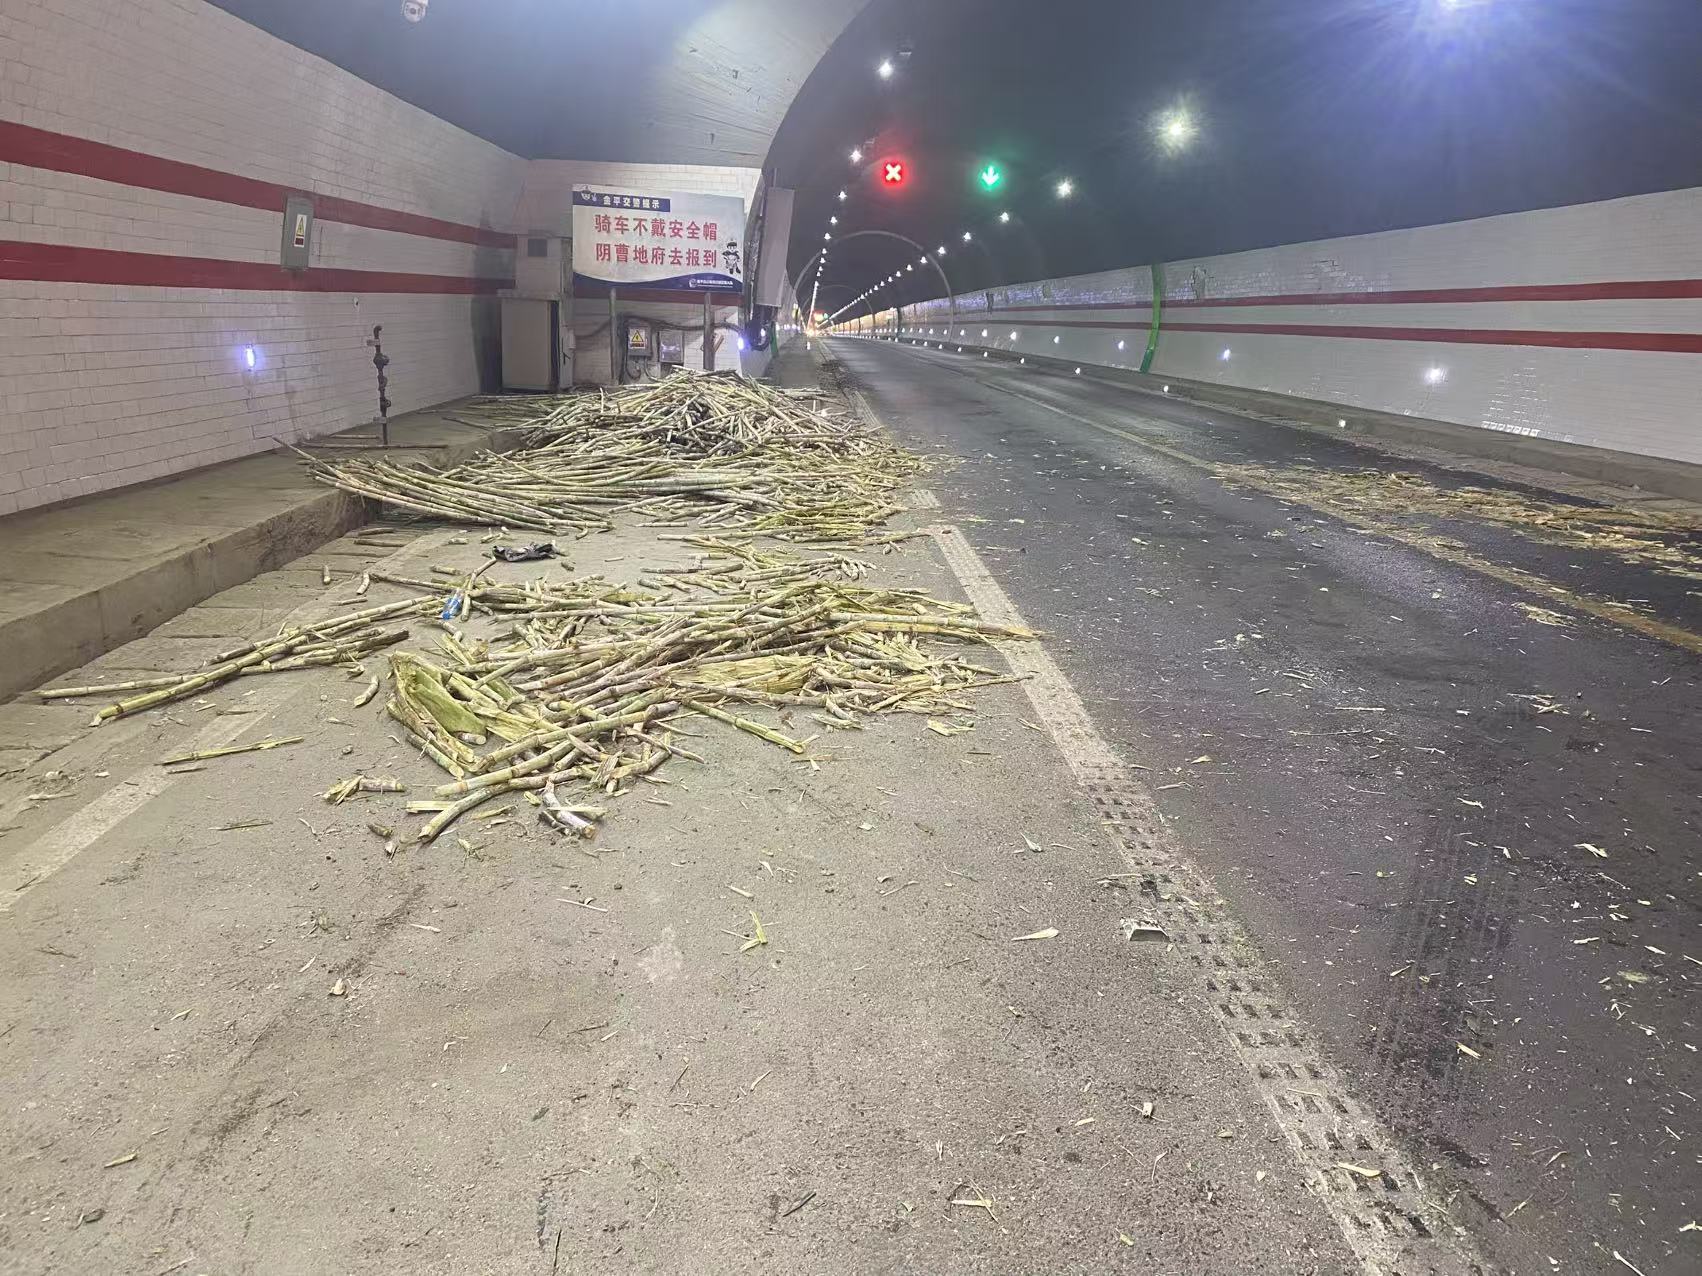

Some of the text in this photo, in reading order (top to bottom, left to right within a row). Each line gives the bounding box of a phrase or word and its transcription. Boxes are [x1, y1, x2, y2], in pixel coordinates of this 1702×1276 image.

[594, 214, 717, 241] 骑车不戴安全帽
[596, 243, 717, 268] 阴曹地府去报到
